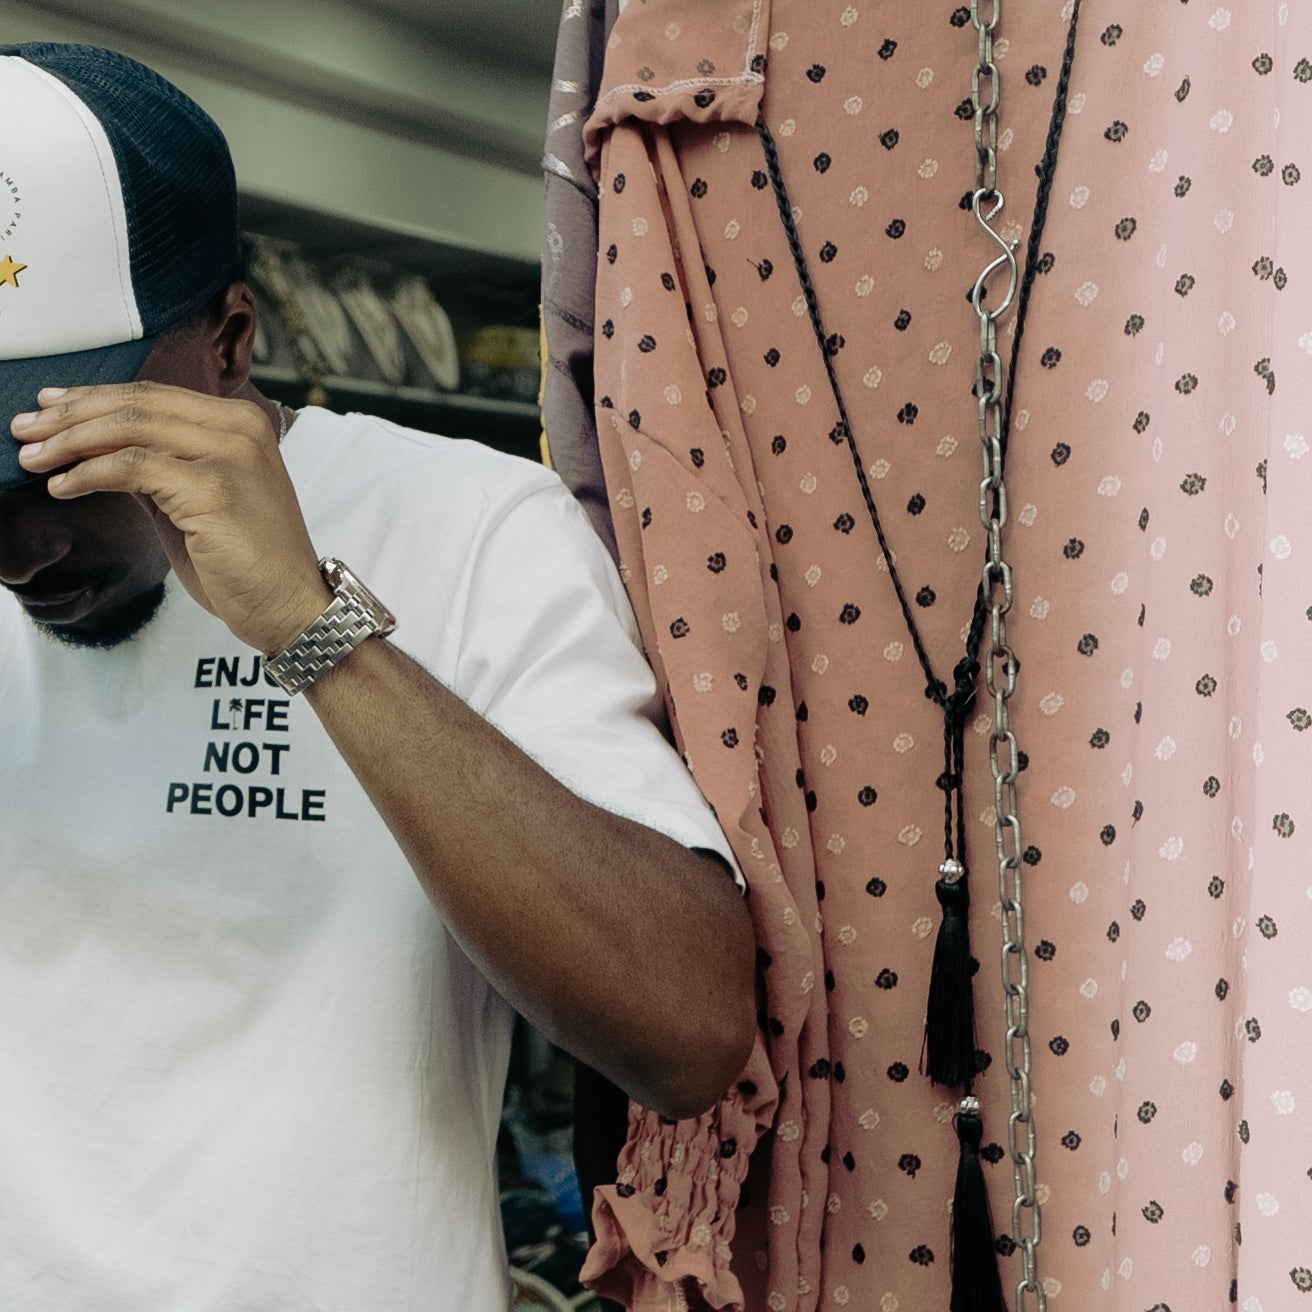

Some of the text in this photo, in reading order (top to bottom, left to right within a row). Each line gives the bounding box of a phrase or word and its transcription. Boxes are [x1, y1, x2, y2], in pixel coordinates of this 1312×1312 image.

[194, 655, 280, 689] ENJ
[202, 741, 291, 776] NOT
[165, 782, 326, 822] PEOPLE
